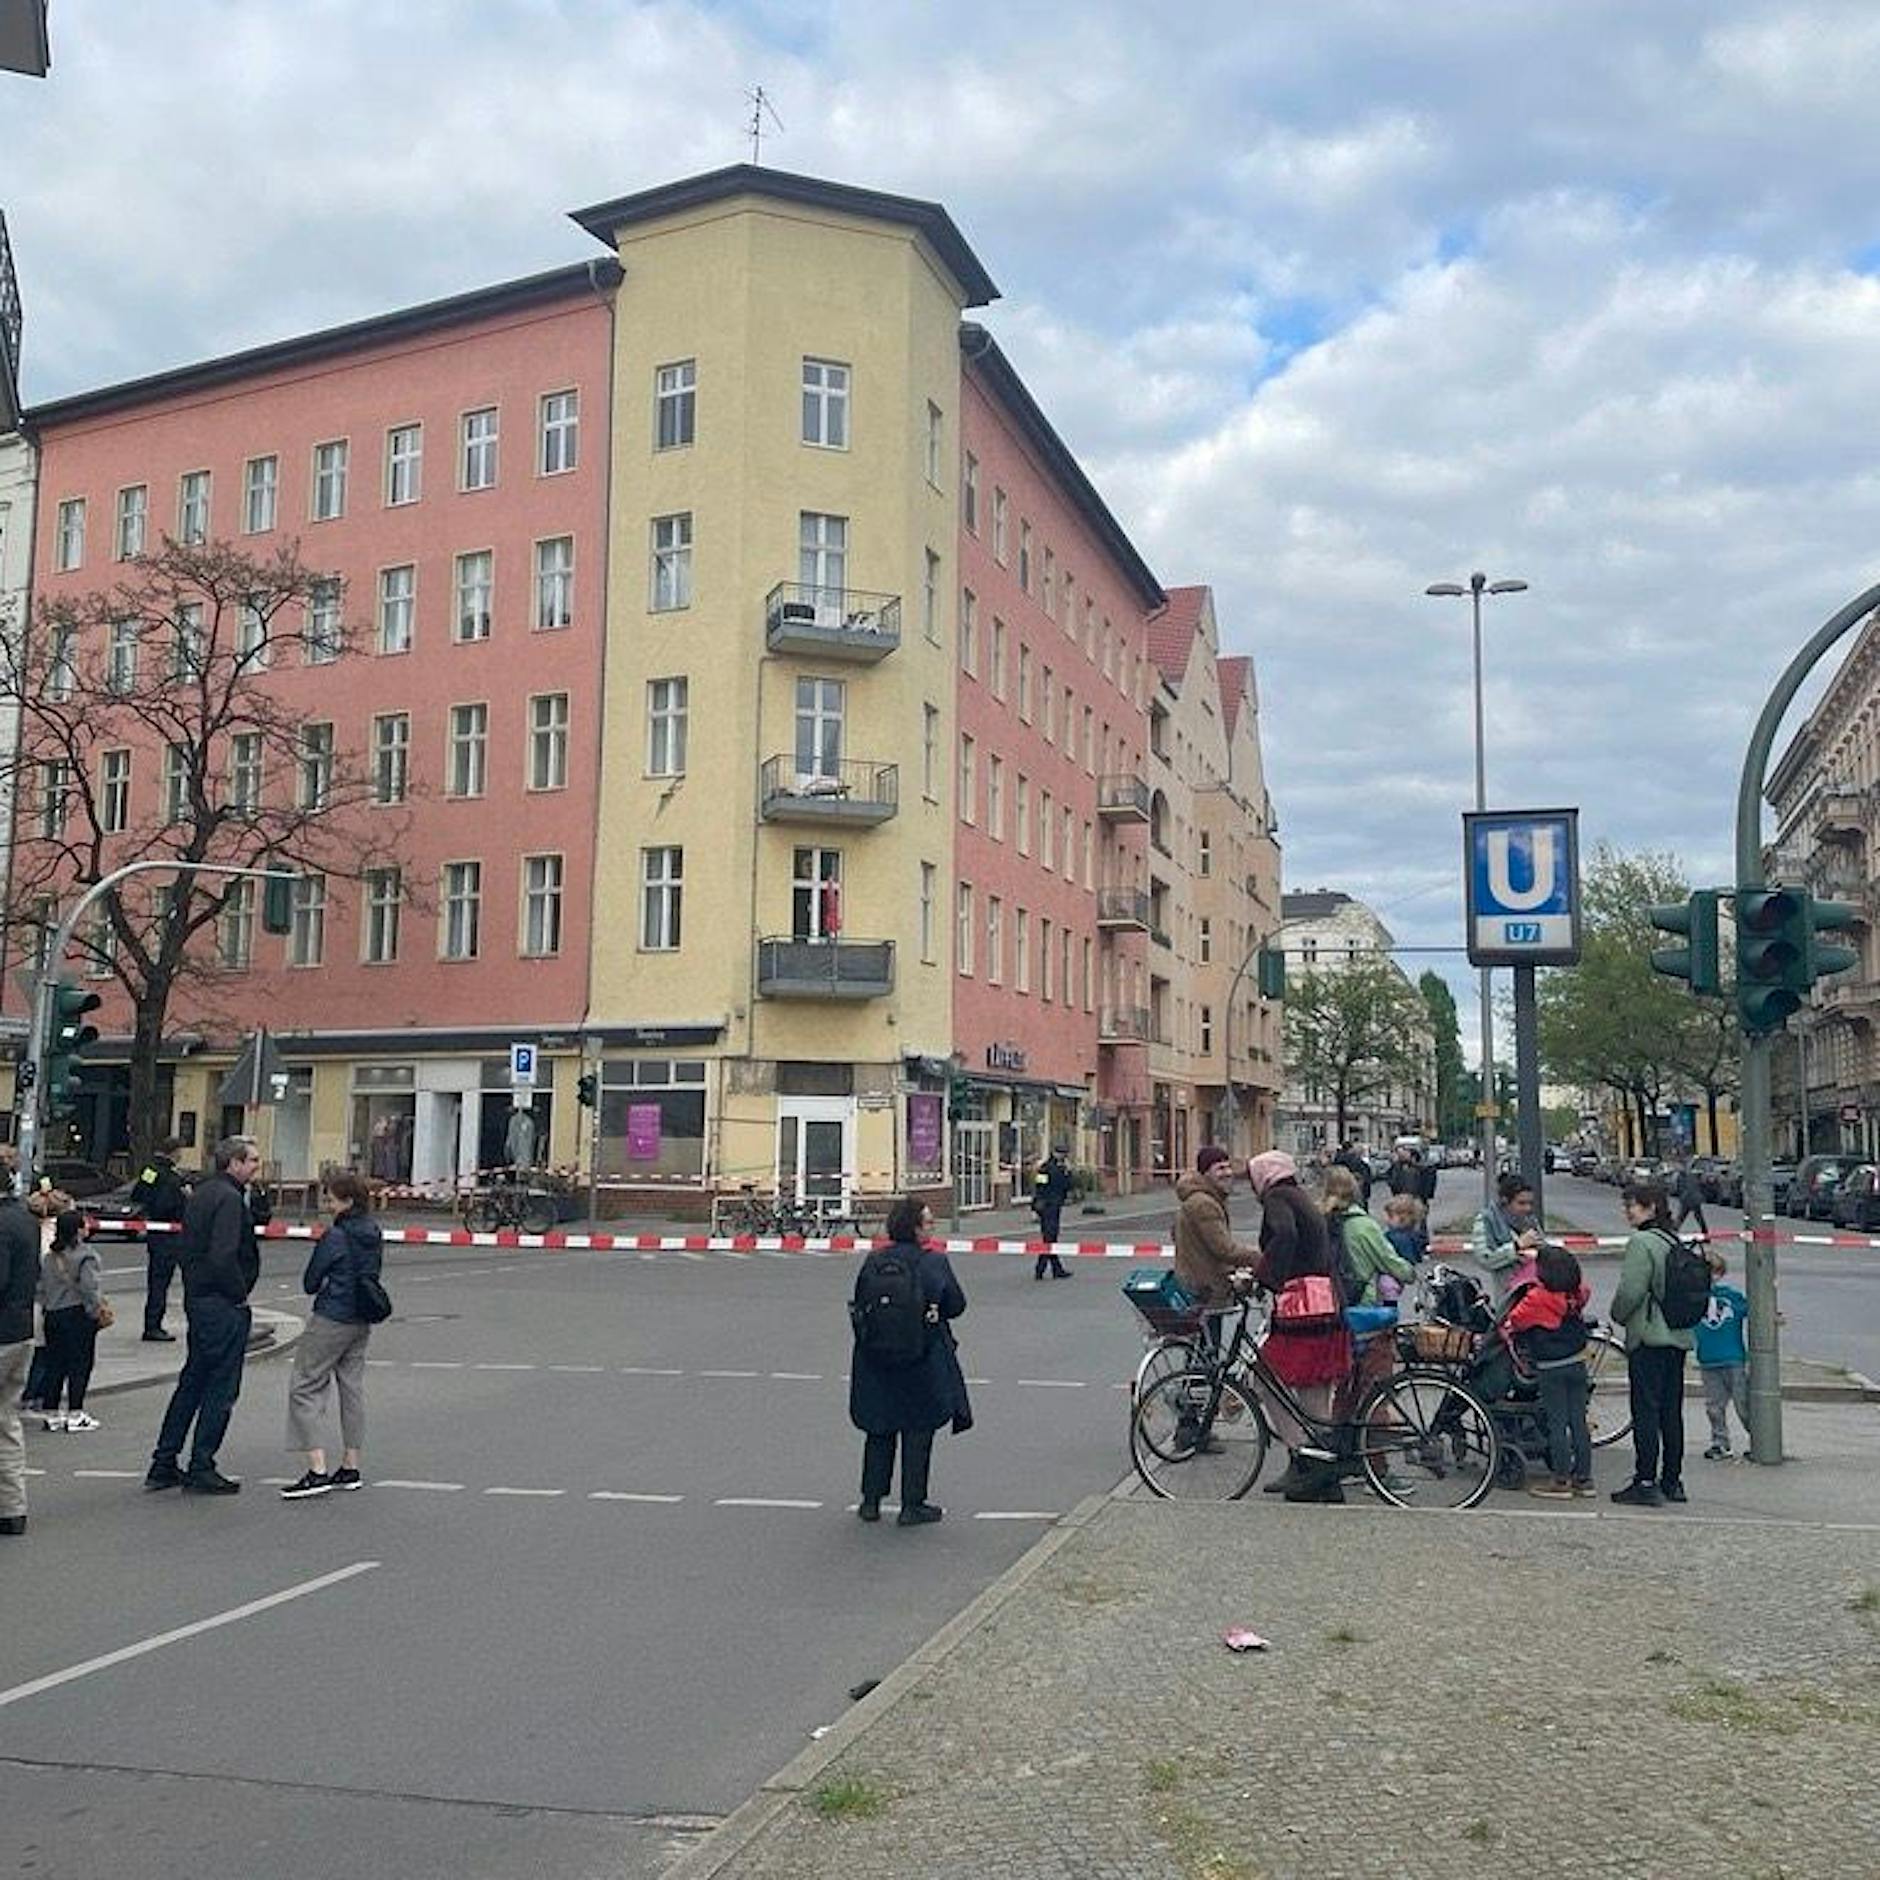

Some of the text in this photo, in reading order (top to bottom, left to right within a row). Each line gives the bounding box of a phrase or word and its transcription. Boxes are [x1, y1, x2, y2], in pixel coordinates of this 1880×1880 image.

[1487, 828, 1555, 911] U
[1508, 923, 1539, 942] U7
[518, 1051, 530, 1070] P
